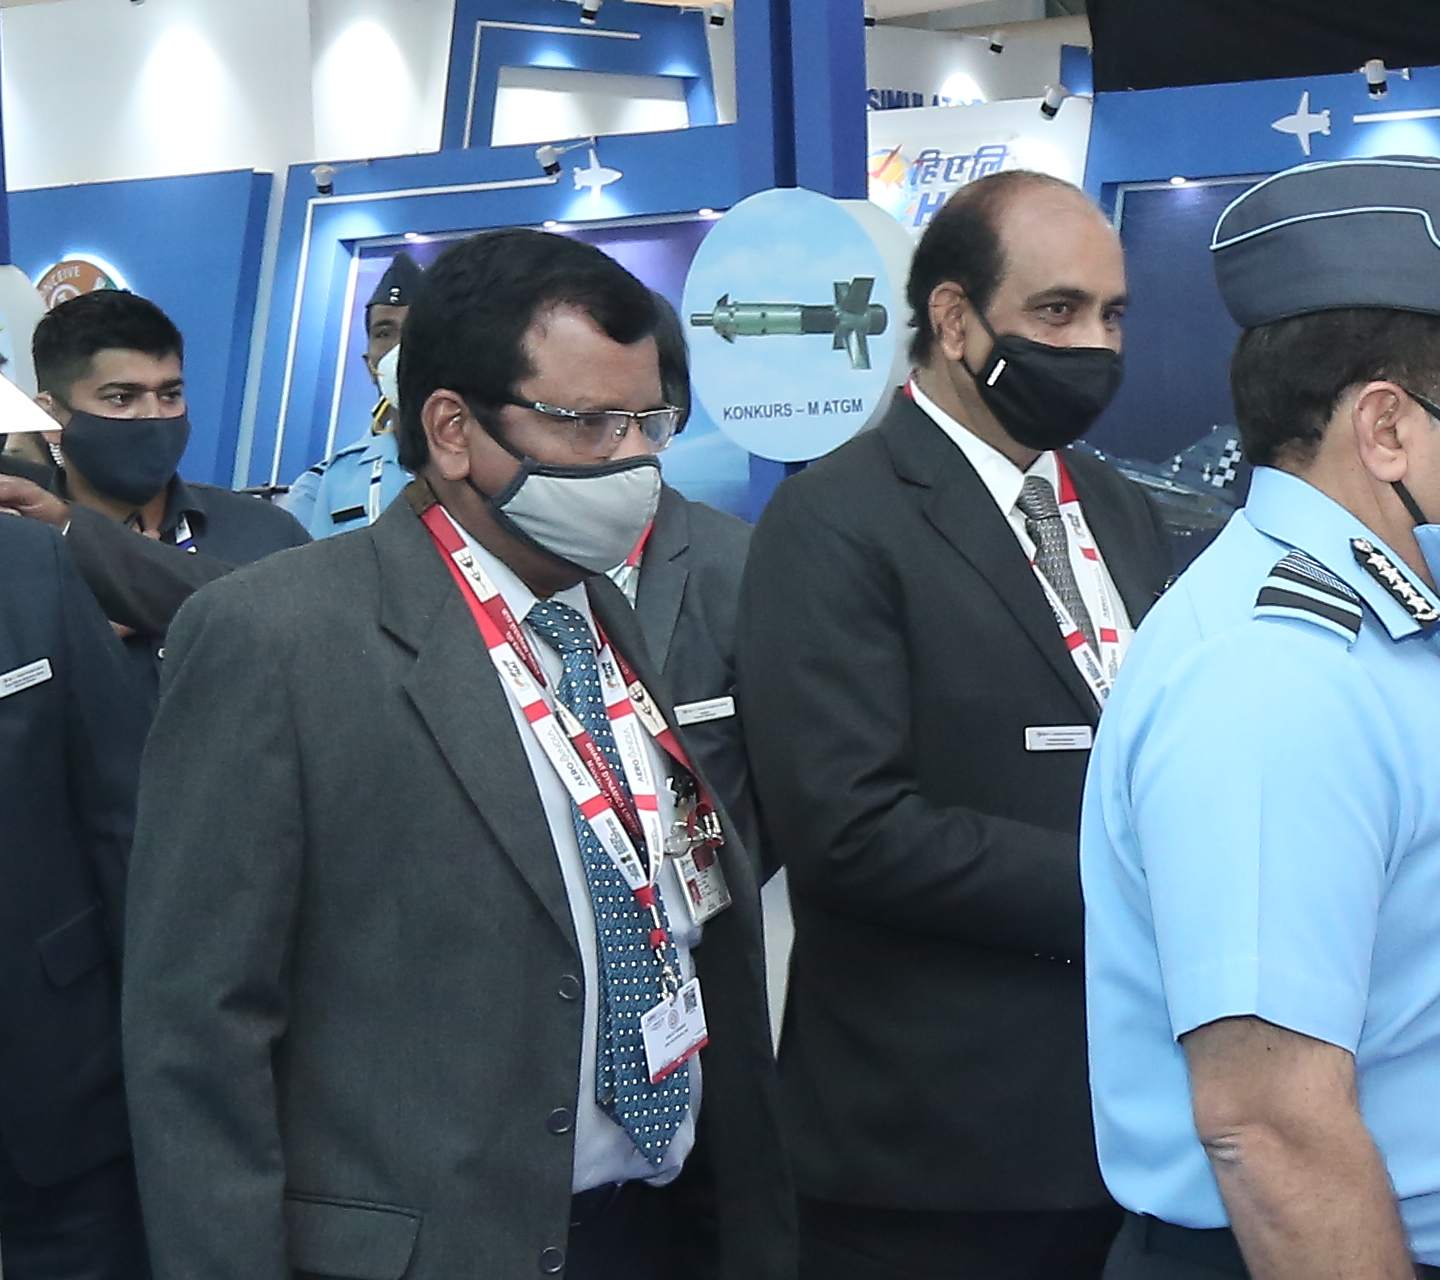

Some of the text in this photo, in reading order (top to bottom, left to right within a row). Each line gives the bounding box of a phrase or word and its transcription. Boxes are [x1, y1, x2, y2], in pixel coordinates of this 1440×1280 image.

[722, 402, 793, 421] KONKURS
[807, 400, 819, 416] M
[822, 398, 864, 415] ATGM
